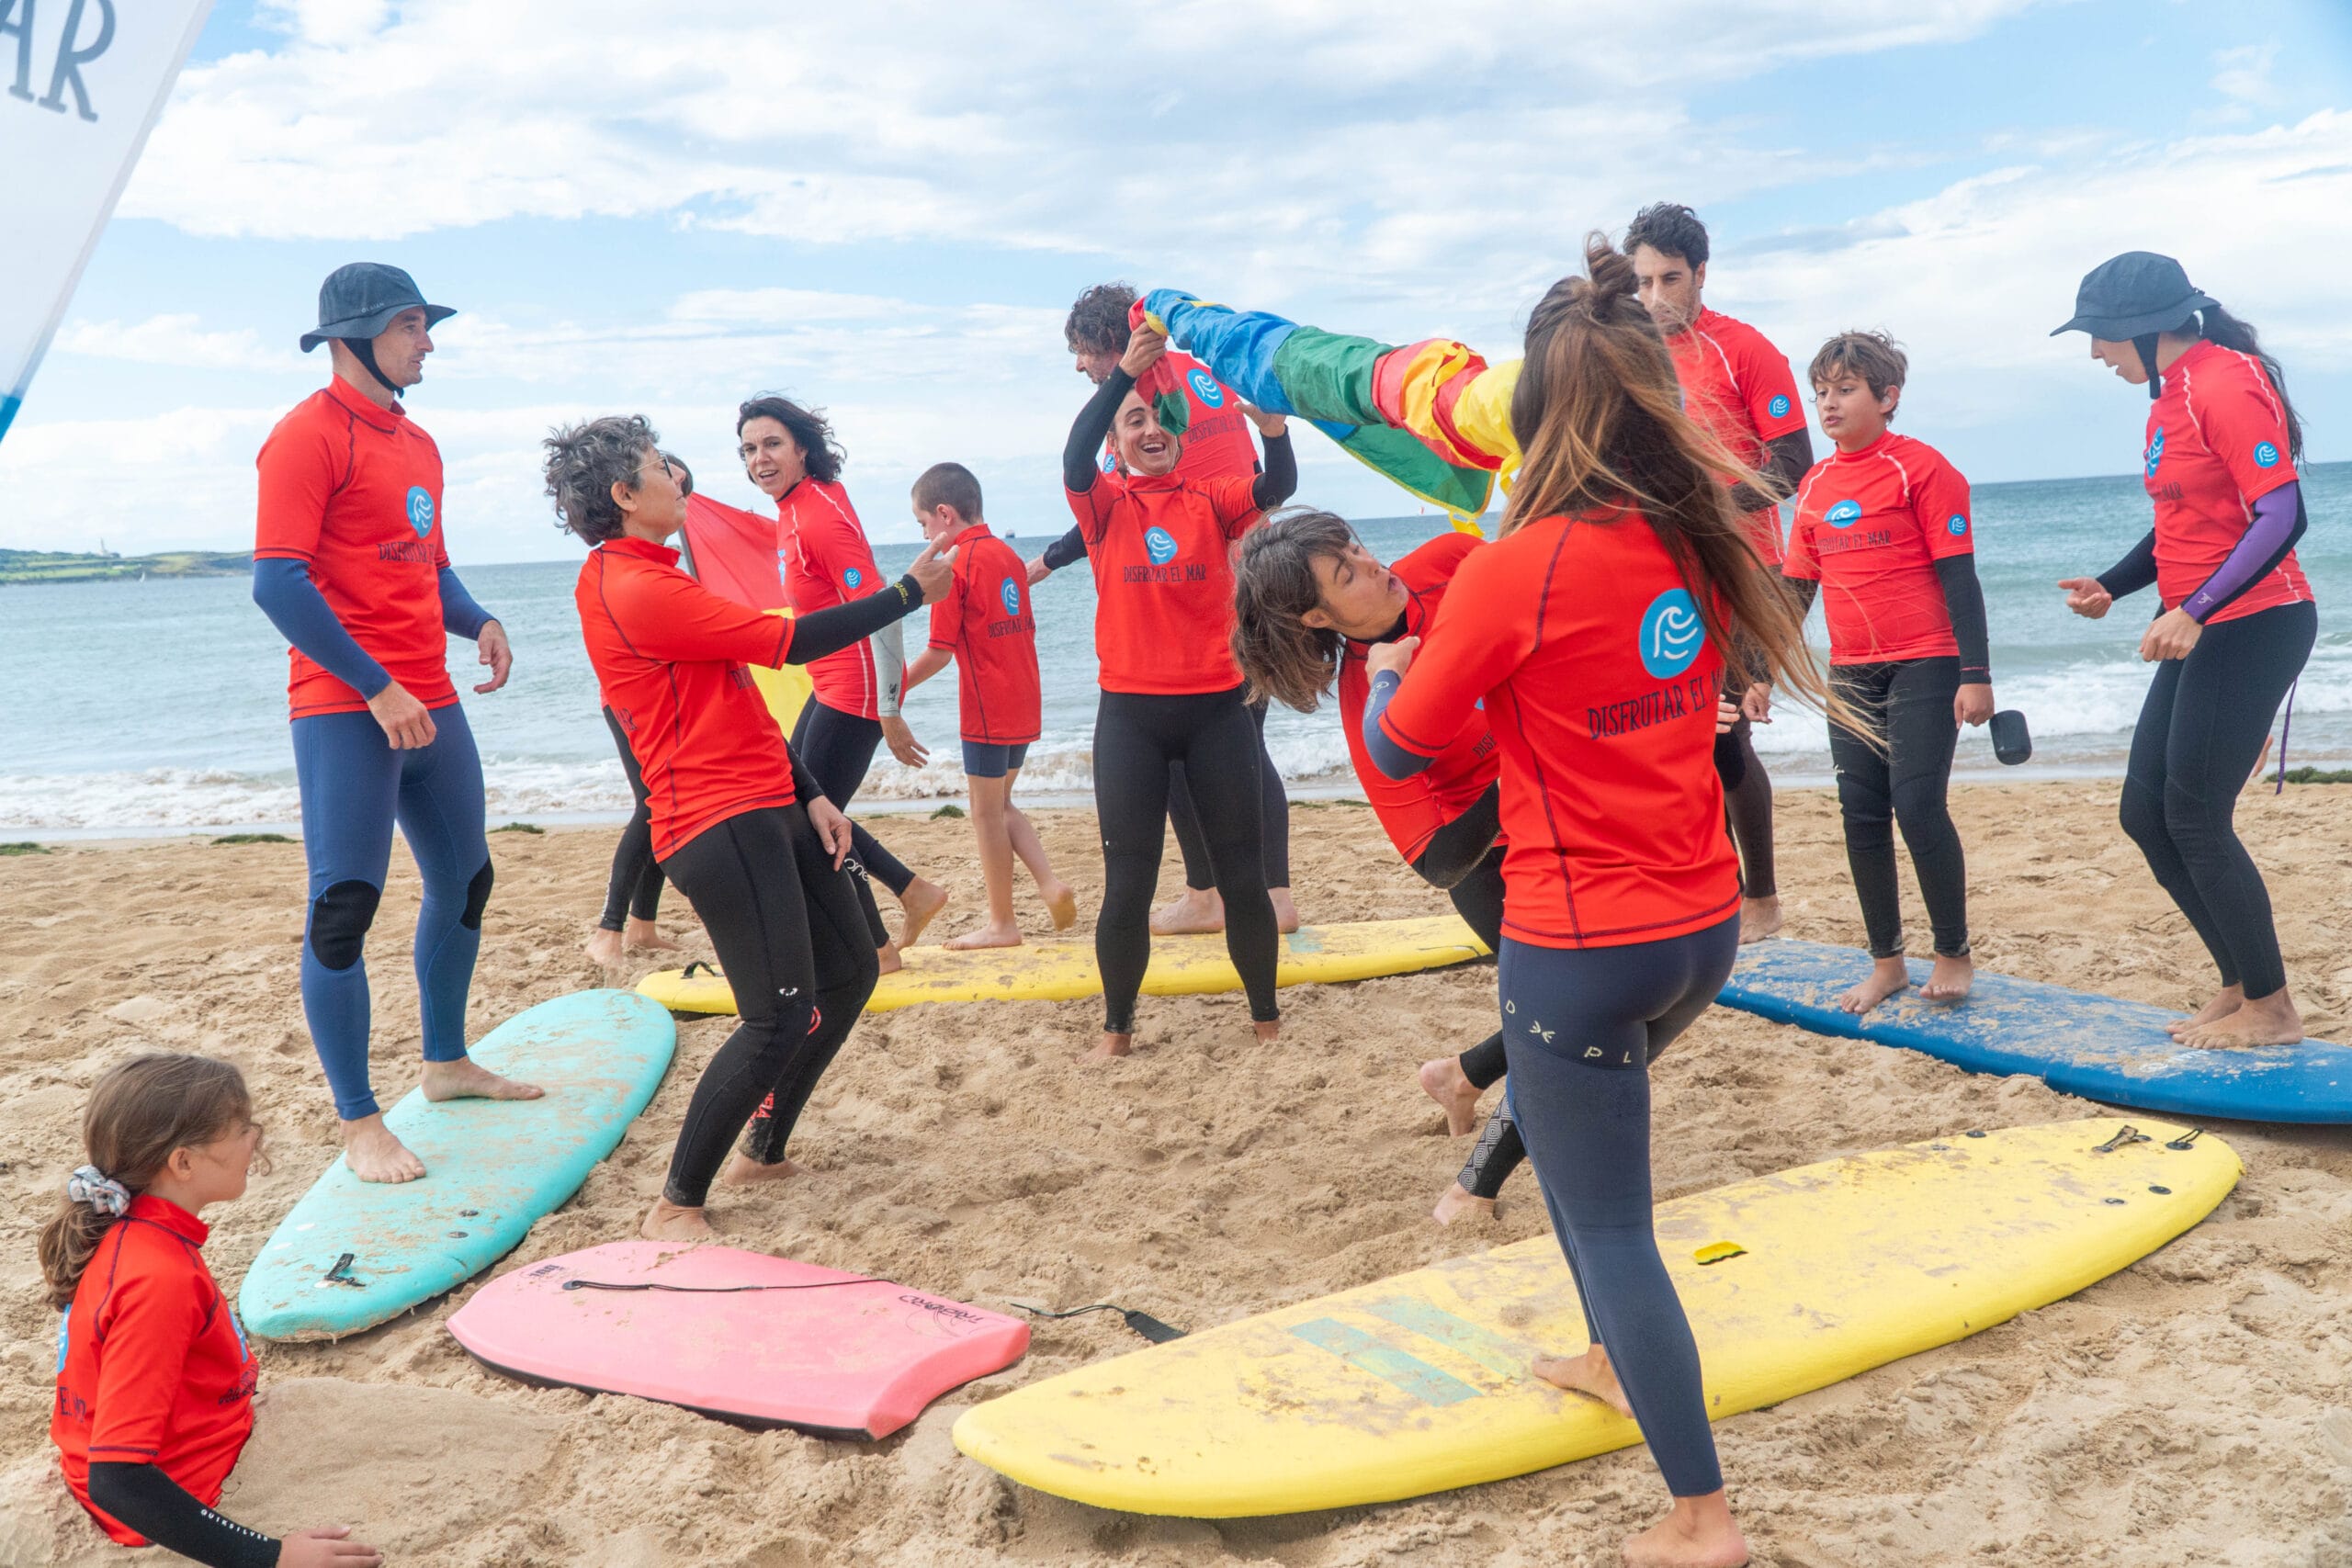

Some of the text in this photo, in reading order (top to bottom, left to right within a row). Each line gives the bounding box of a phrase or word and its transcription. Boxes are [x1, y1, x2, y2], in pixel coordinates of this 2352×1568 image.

[1867, 529, 1891, 547] MAR
[1170, 566, 1183, 581] EL
[1185, 563, 1206, 581] MAR
[1588, 684, 1688, 740] DISFRUTAR
[1689, 675, 1707, 712] EL
[200, 1508, 269, 1541] QUIKSILVER
